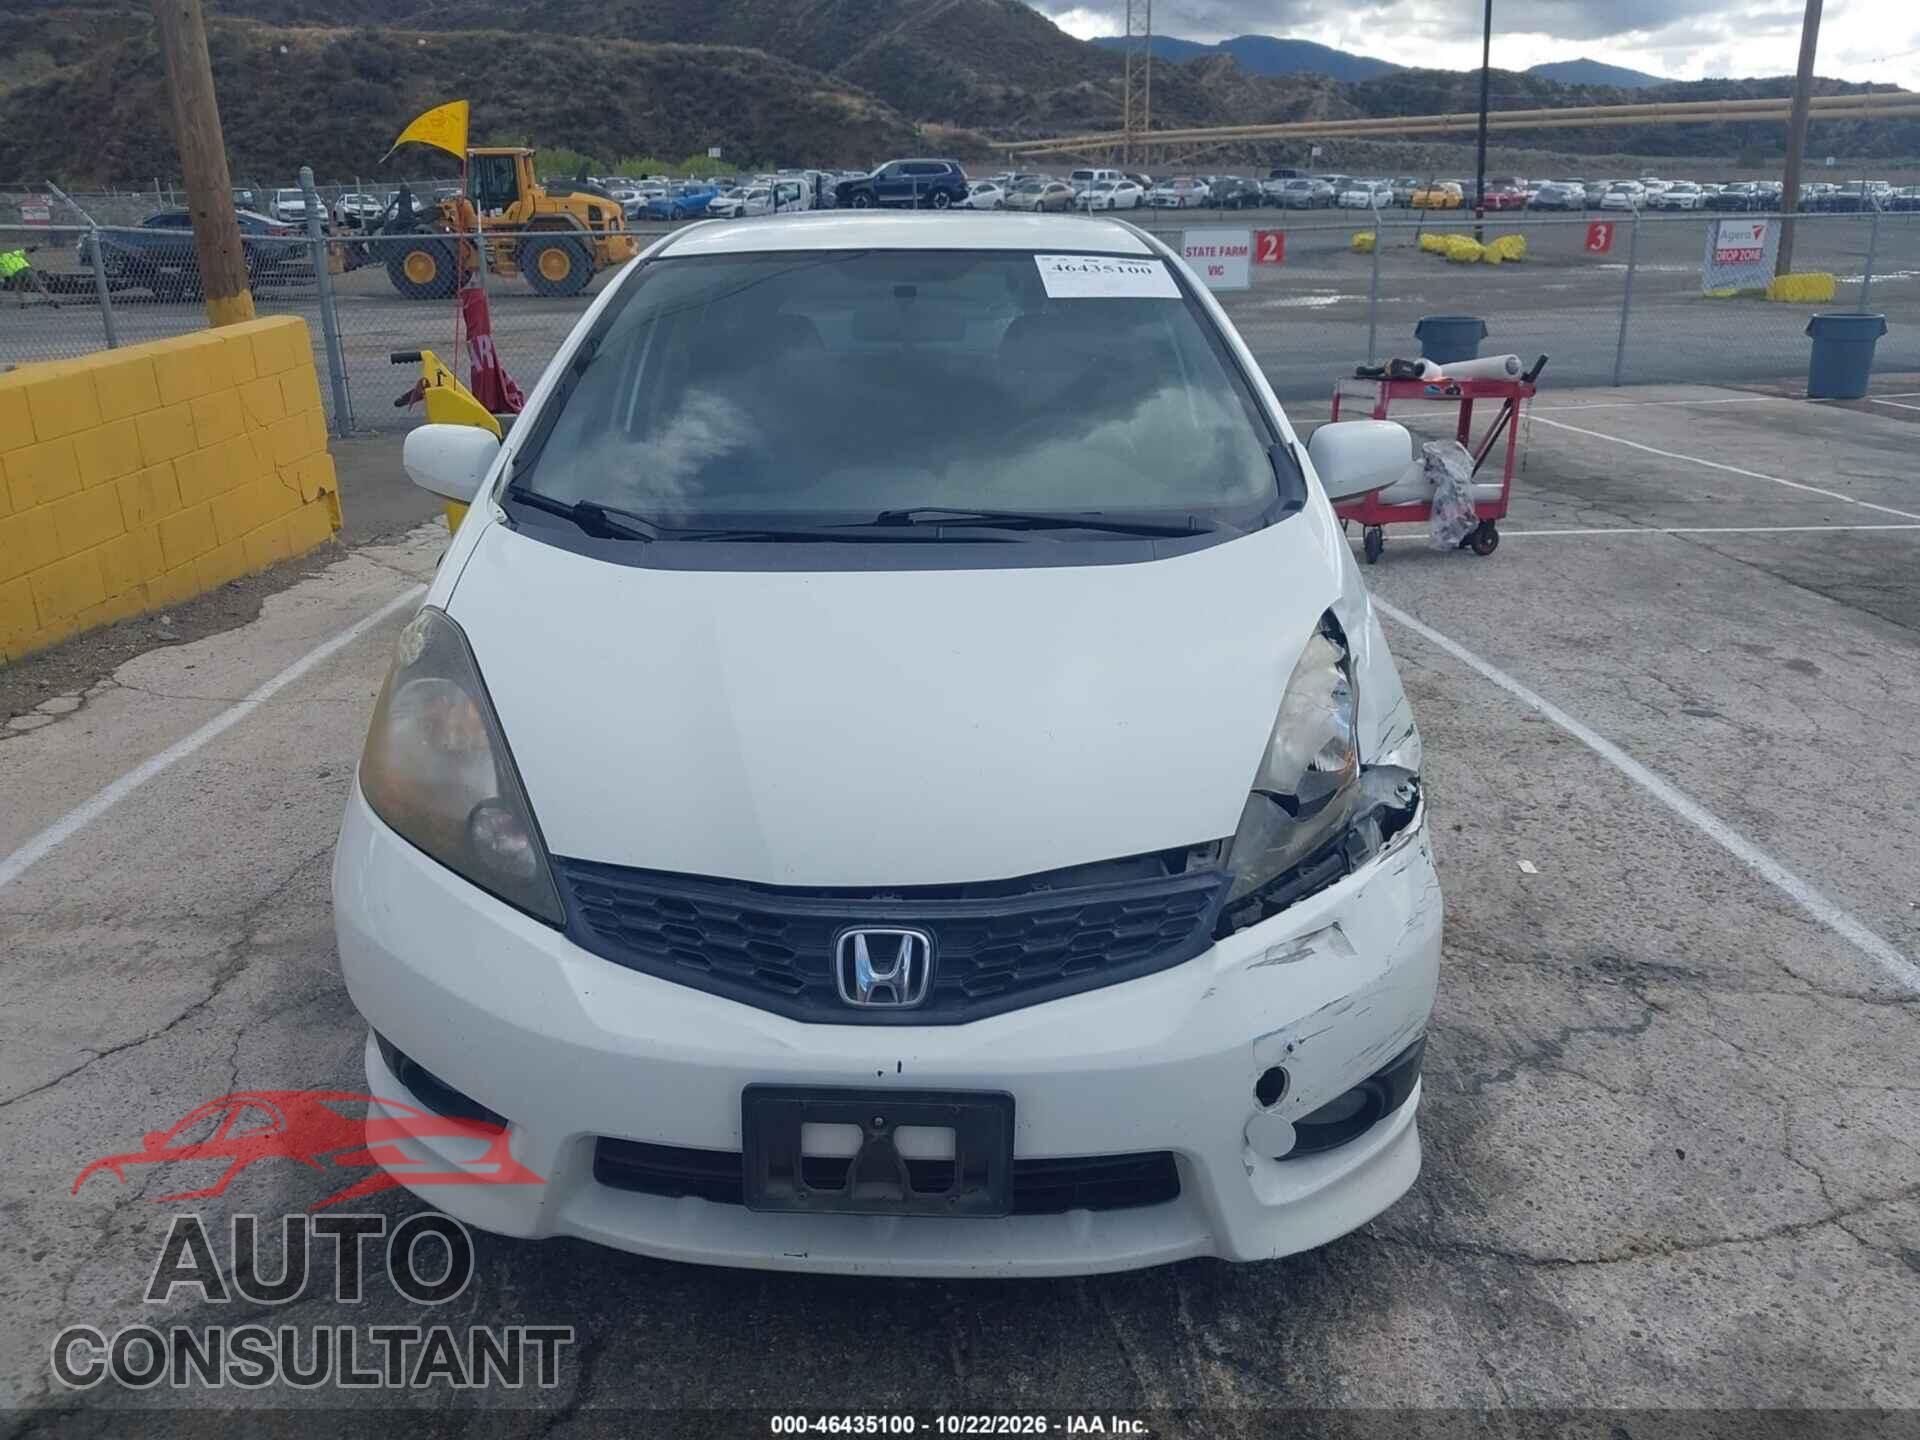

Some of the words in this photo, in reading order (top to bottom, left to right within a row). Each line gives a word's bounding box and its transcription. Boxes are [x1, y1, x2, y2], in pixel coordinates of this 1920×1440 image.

[1591, 225, 1607, 250] 3
[1185, 246, 1216, 257] STATE
[1219, 246, 1248, 257] FARM
[1263, 235, 1278, 261] 2
[1716, 249, 1737, 261] DROP
[1739, 249, 1761, 260] ZONE
[1208, 264, 1224, 276] VIC
